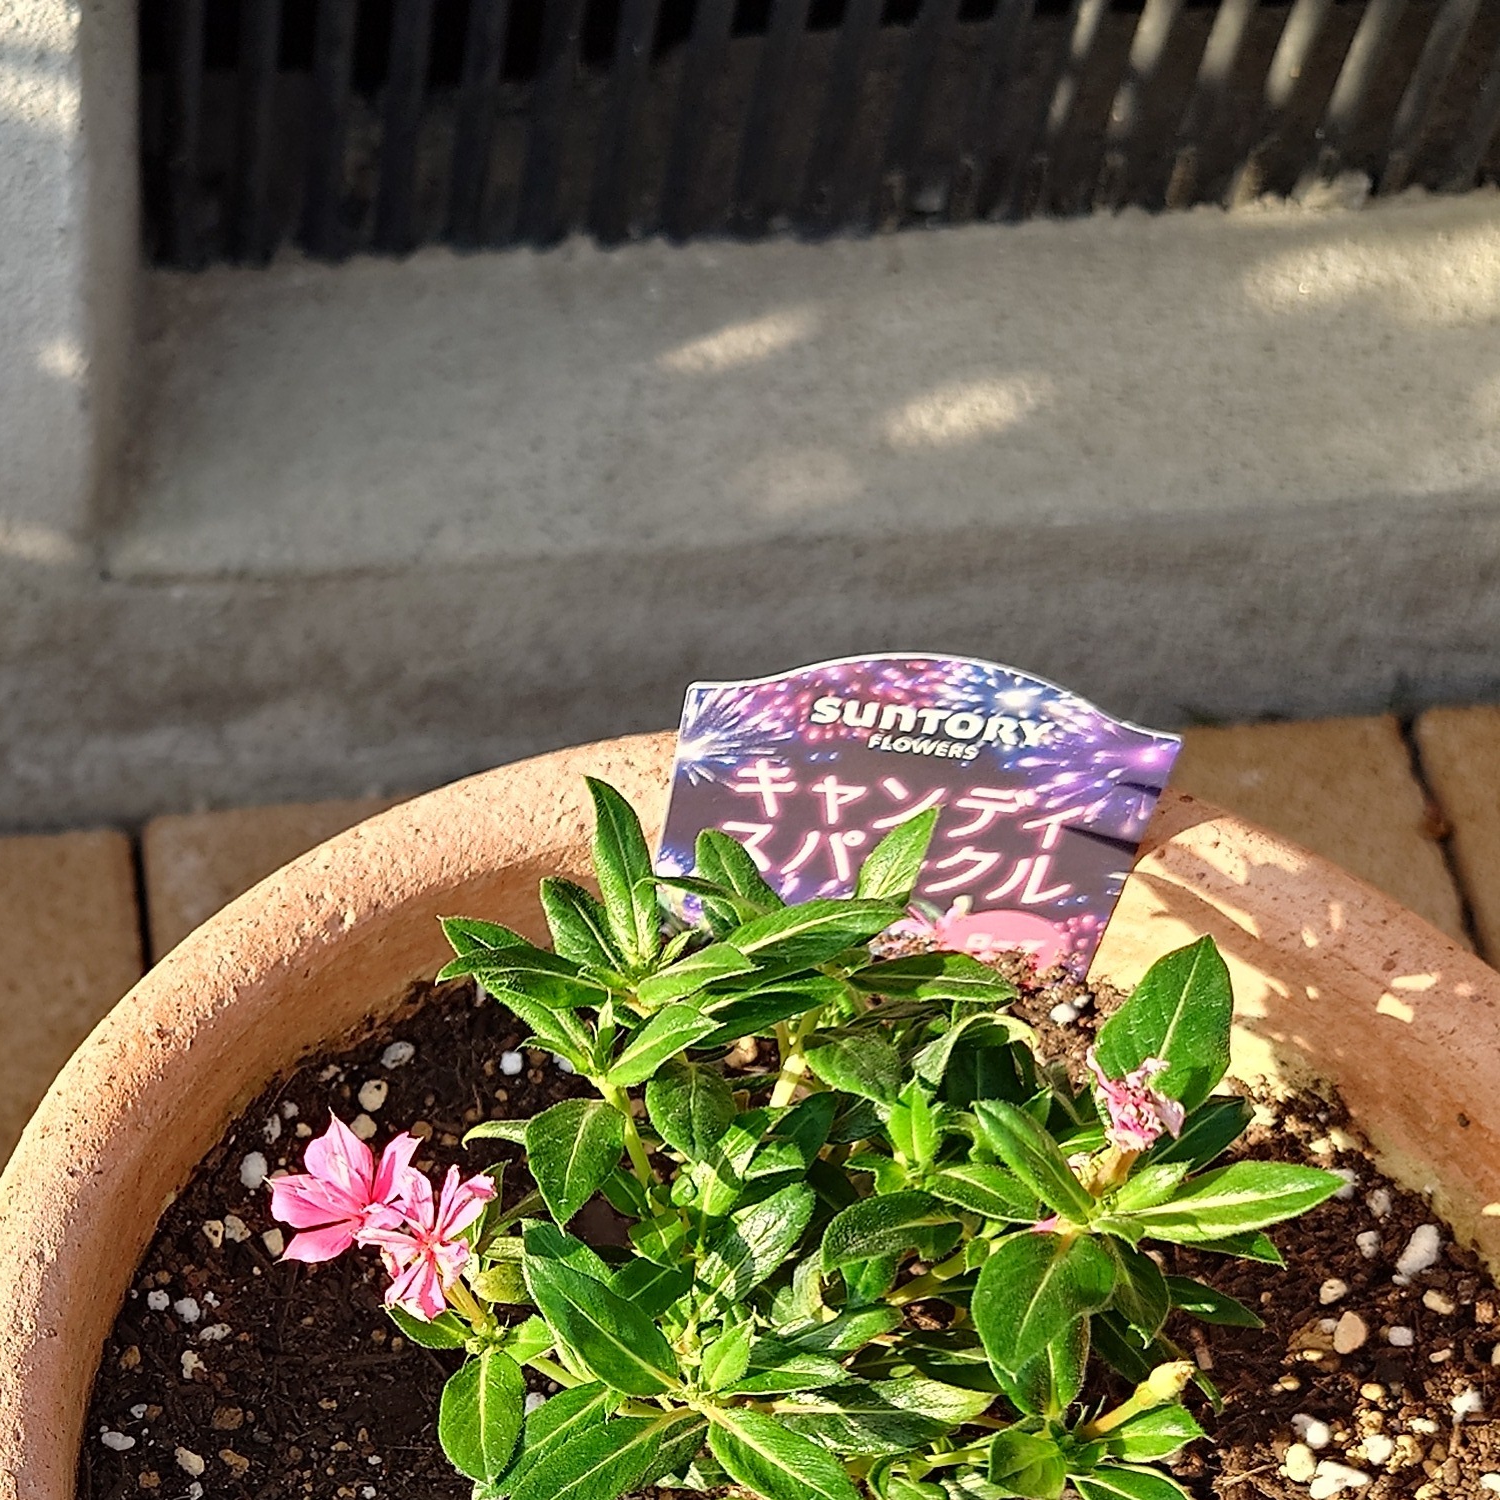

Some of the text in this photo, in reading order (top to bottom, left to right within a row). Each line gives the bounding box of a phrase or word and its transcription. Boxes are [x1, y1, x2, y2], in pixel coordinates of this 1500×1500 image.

[811, 696, 1056, 748] SUNTORY
[868, 733, 980, 761] FLOWERS
[735, 758, 1085, 850] キャンディ
[722, 820, 1073, 904] スパクル
